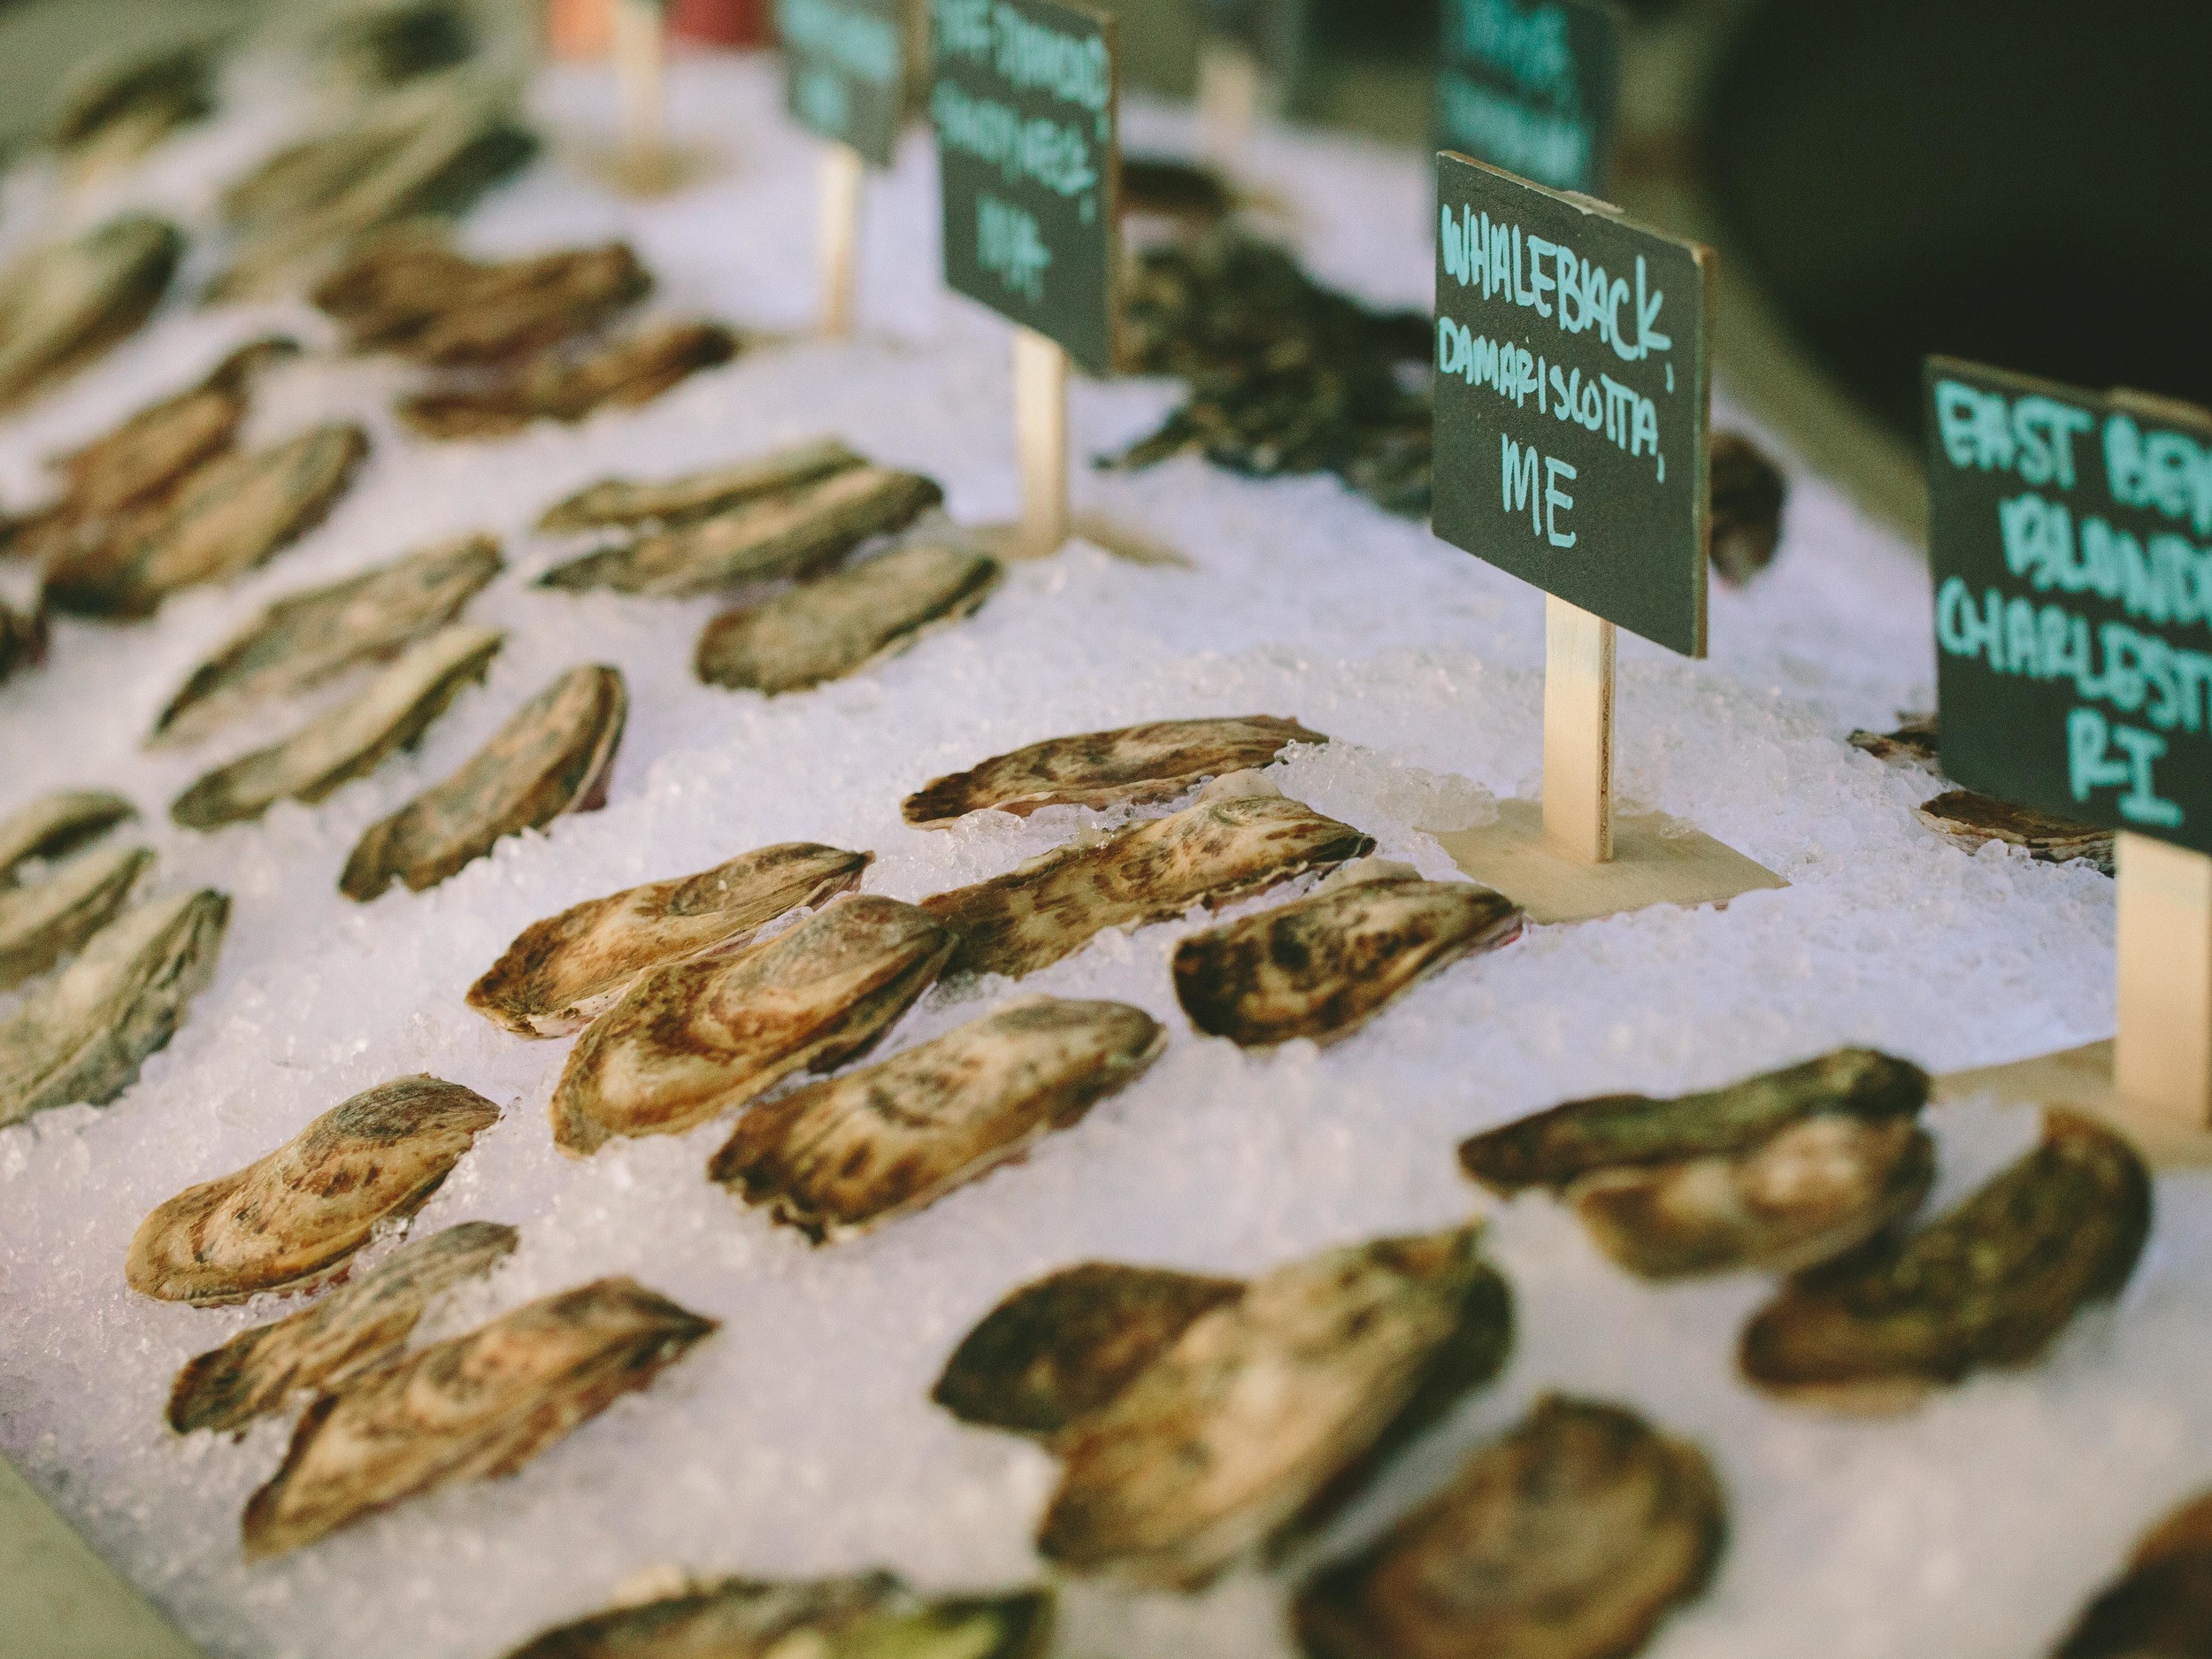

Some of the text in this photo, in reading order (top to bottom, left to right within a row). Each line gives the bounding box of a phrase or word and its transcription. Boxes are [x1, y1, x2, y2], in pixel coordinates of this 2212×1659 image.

[1502, 432, 1577, 549] ME
[1935, 379, 2097, 490] EAST
[1937, 575, 2212, 734] CHARLEST
[2066, 708, 2184, 828] RI
